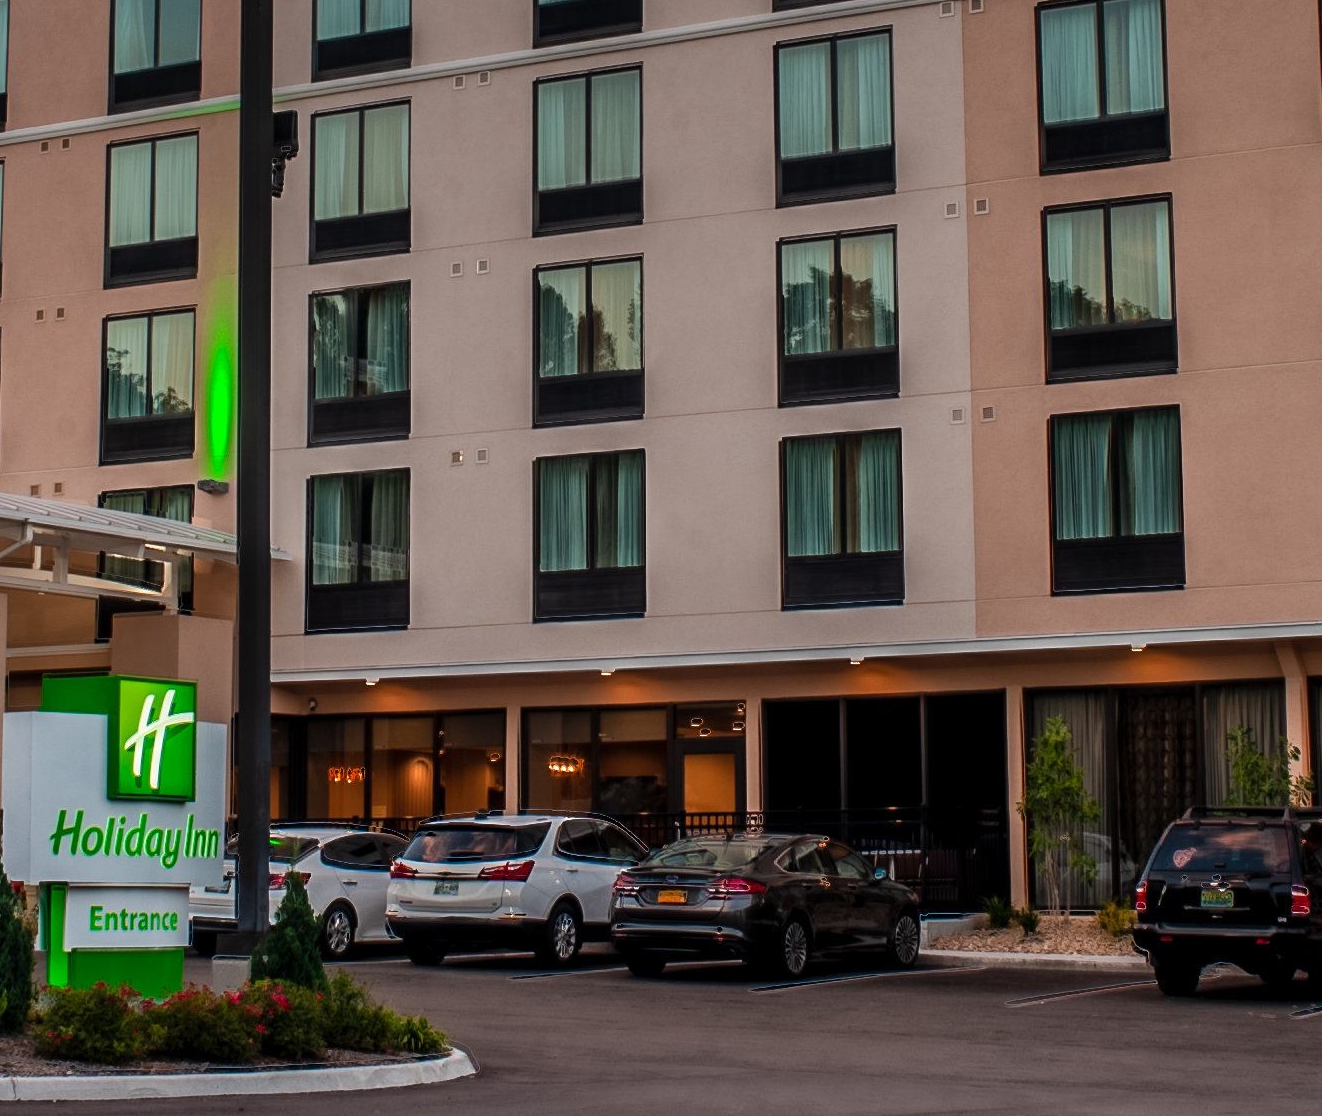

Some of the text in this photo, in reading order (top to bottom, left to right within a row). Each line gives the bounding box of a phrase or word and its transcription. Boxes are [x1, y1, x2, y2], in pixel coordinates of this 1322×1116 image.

[125, 689, 195, 789] H
[50, 809, 219, 869] Holiday Inn
[89, 905, 178, 932] Entrance
